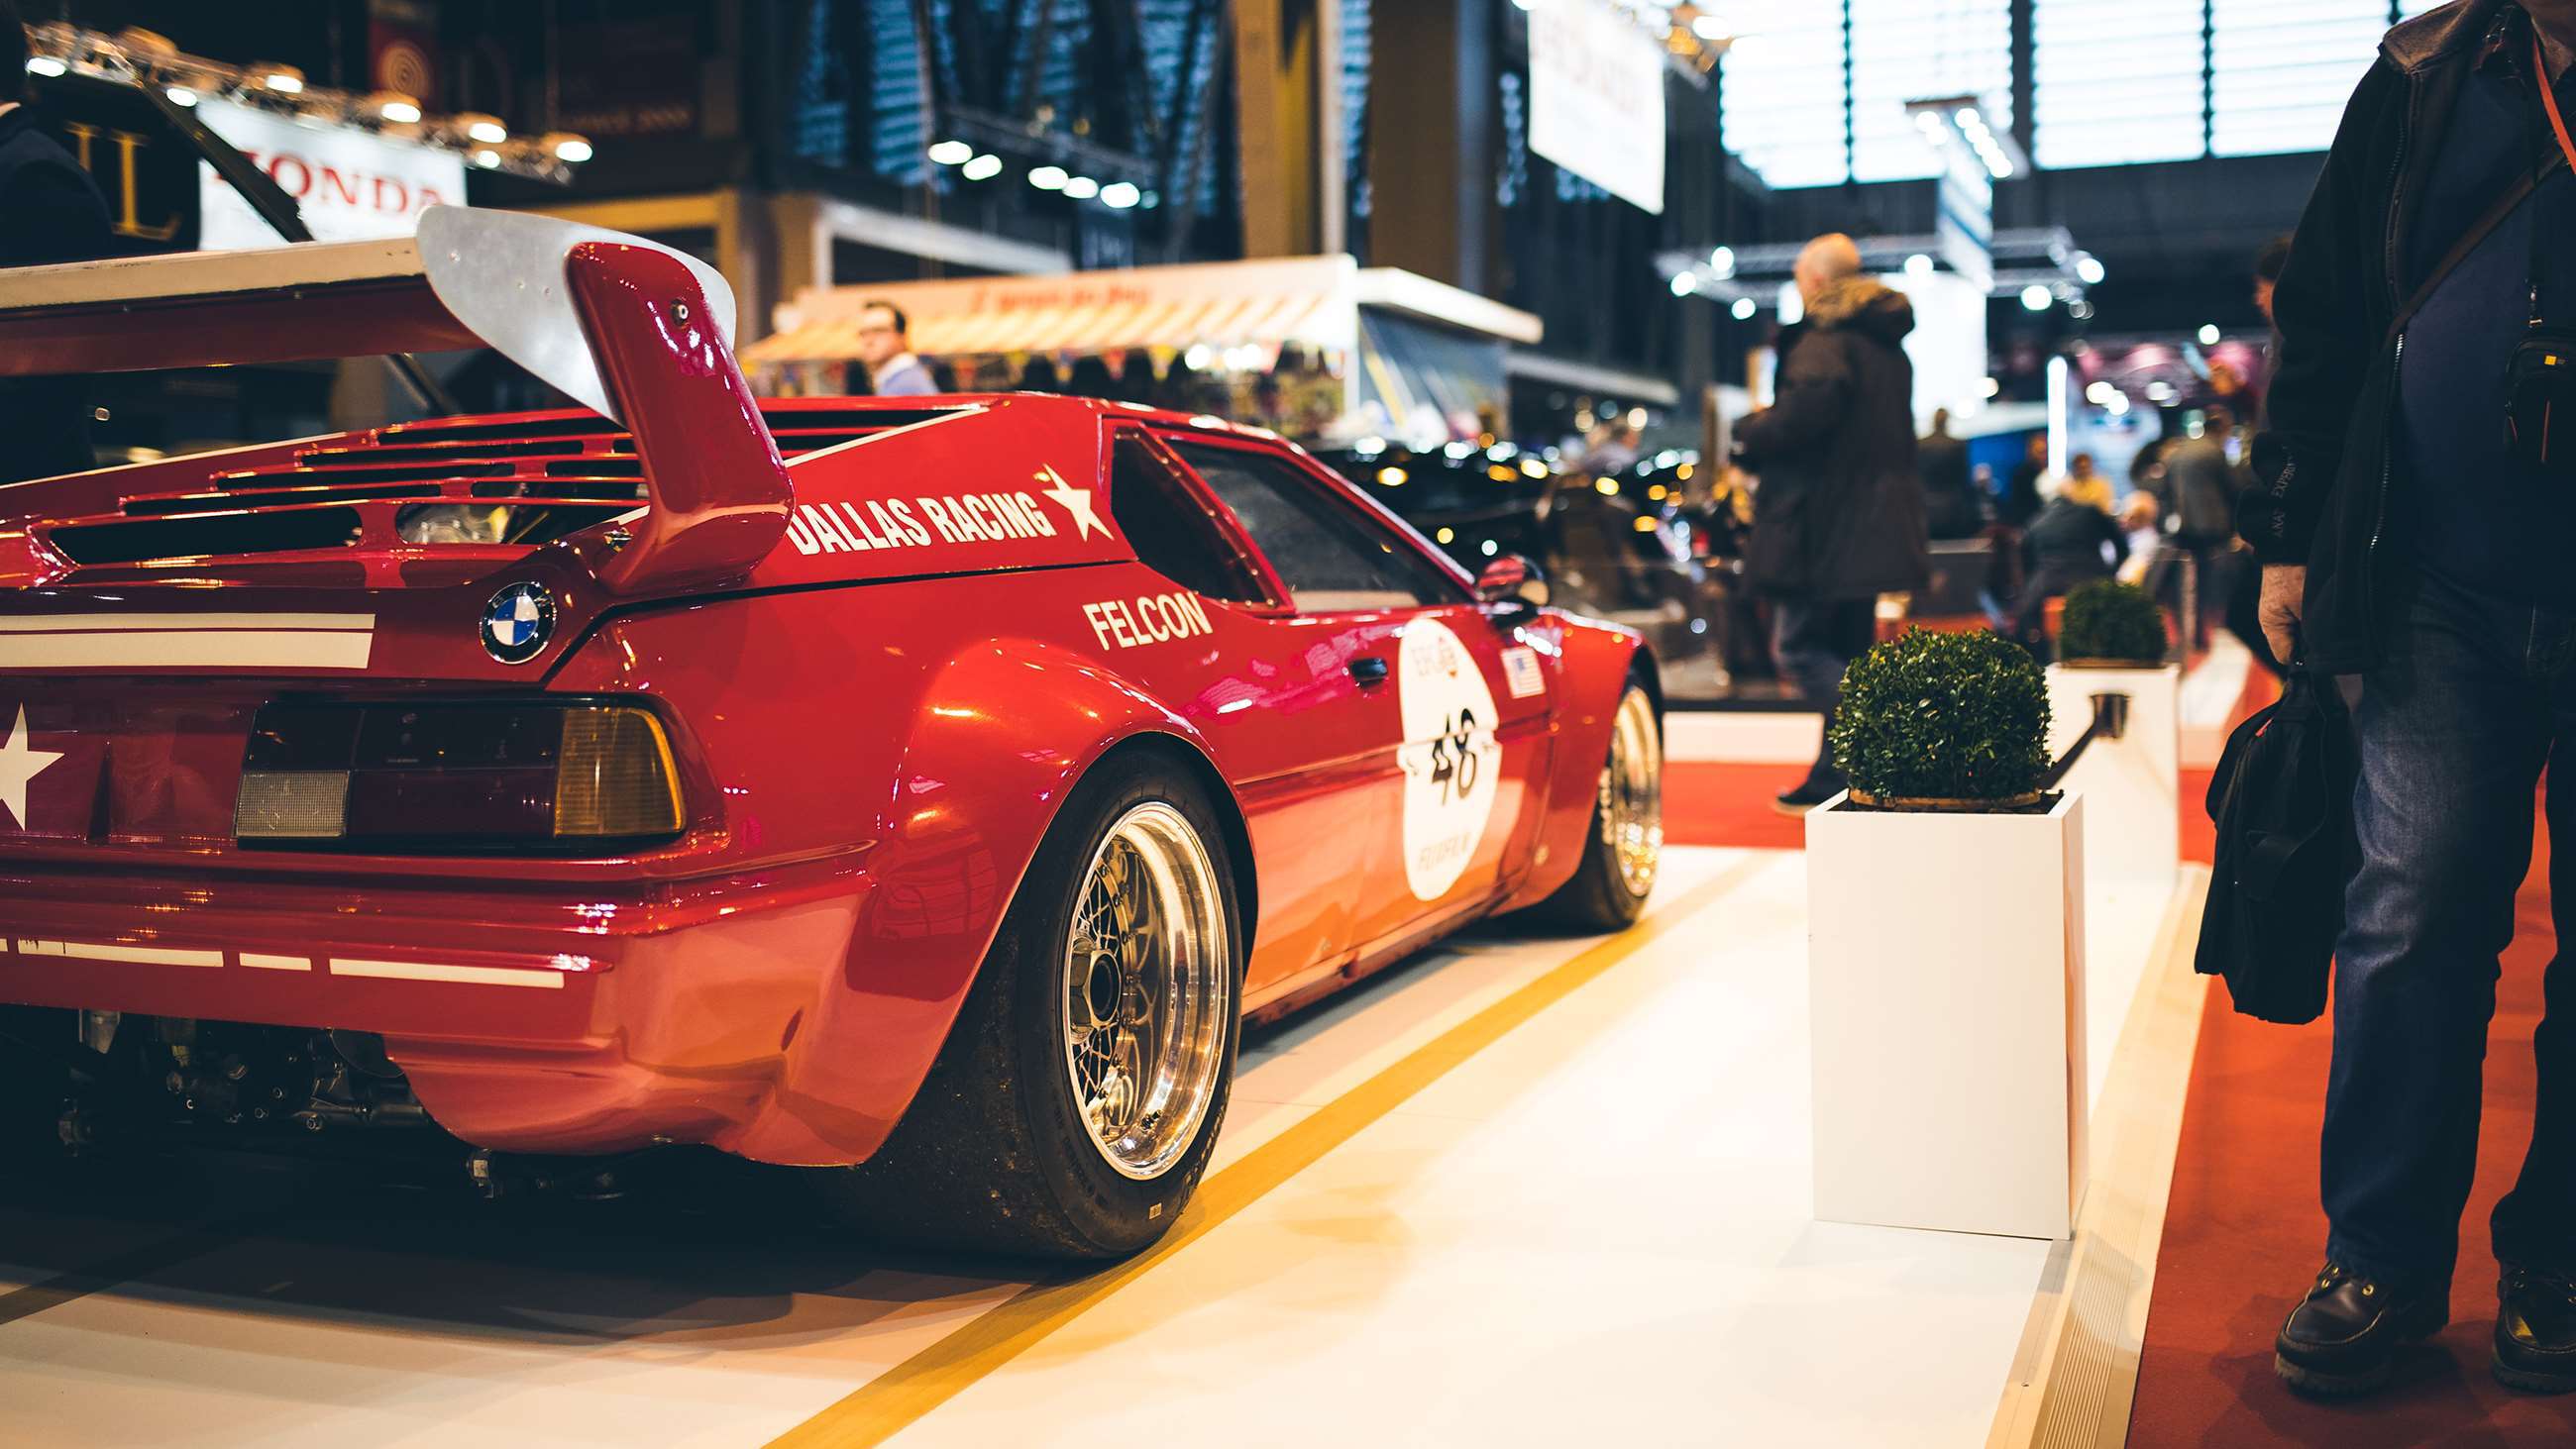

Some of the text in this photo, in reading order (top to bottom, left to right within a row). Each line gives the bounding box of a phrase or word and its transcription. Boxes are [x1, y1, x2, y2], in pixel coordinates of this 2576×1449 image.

[212, 150, 444, 214] OND
[786, 491, 1057, 556] DALLAS RACING
[1082, 590, 1214, 651] FELCON
[1432, 707, 1477, 806] 48
